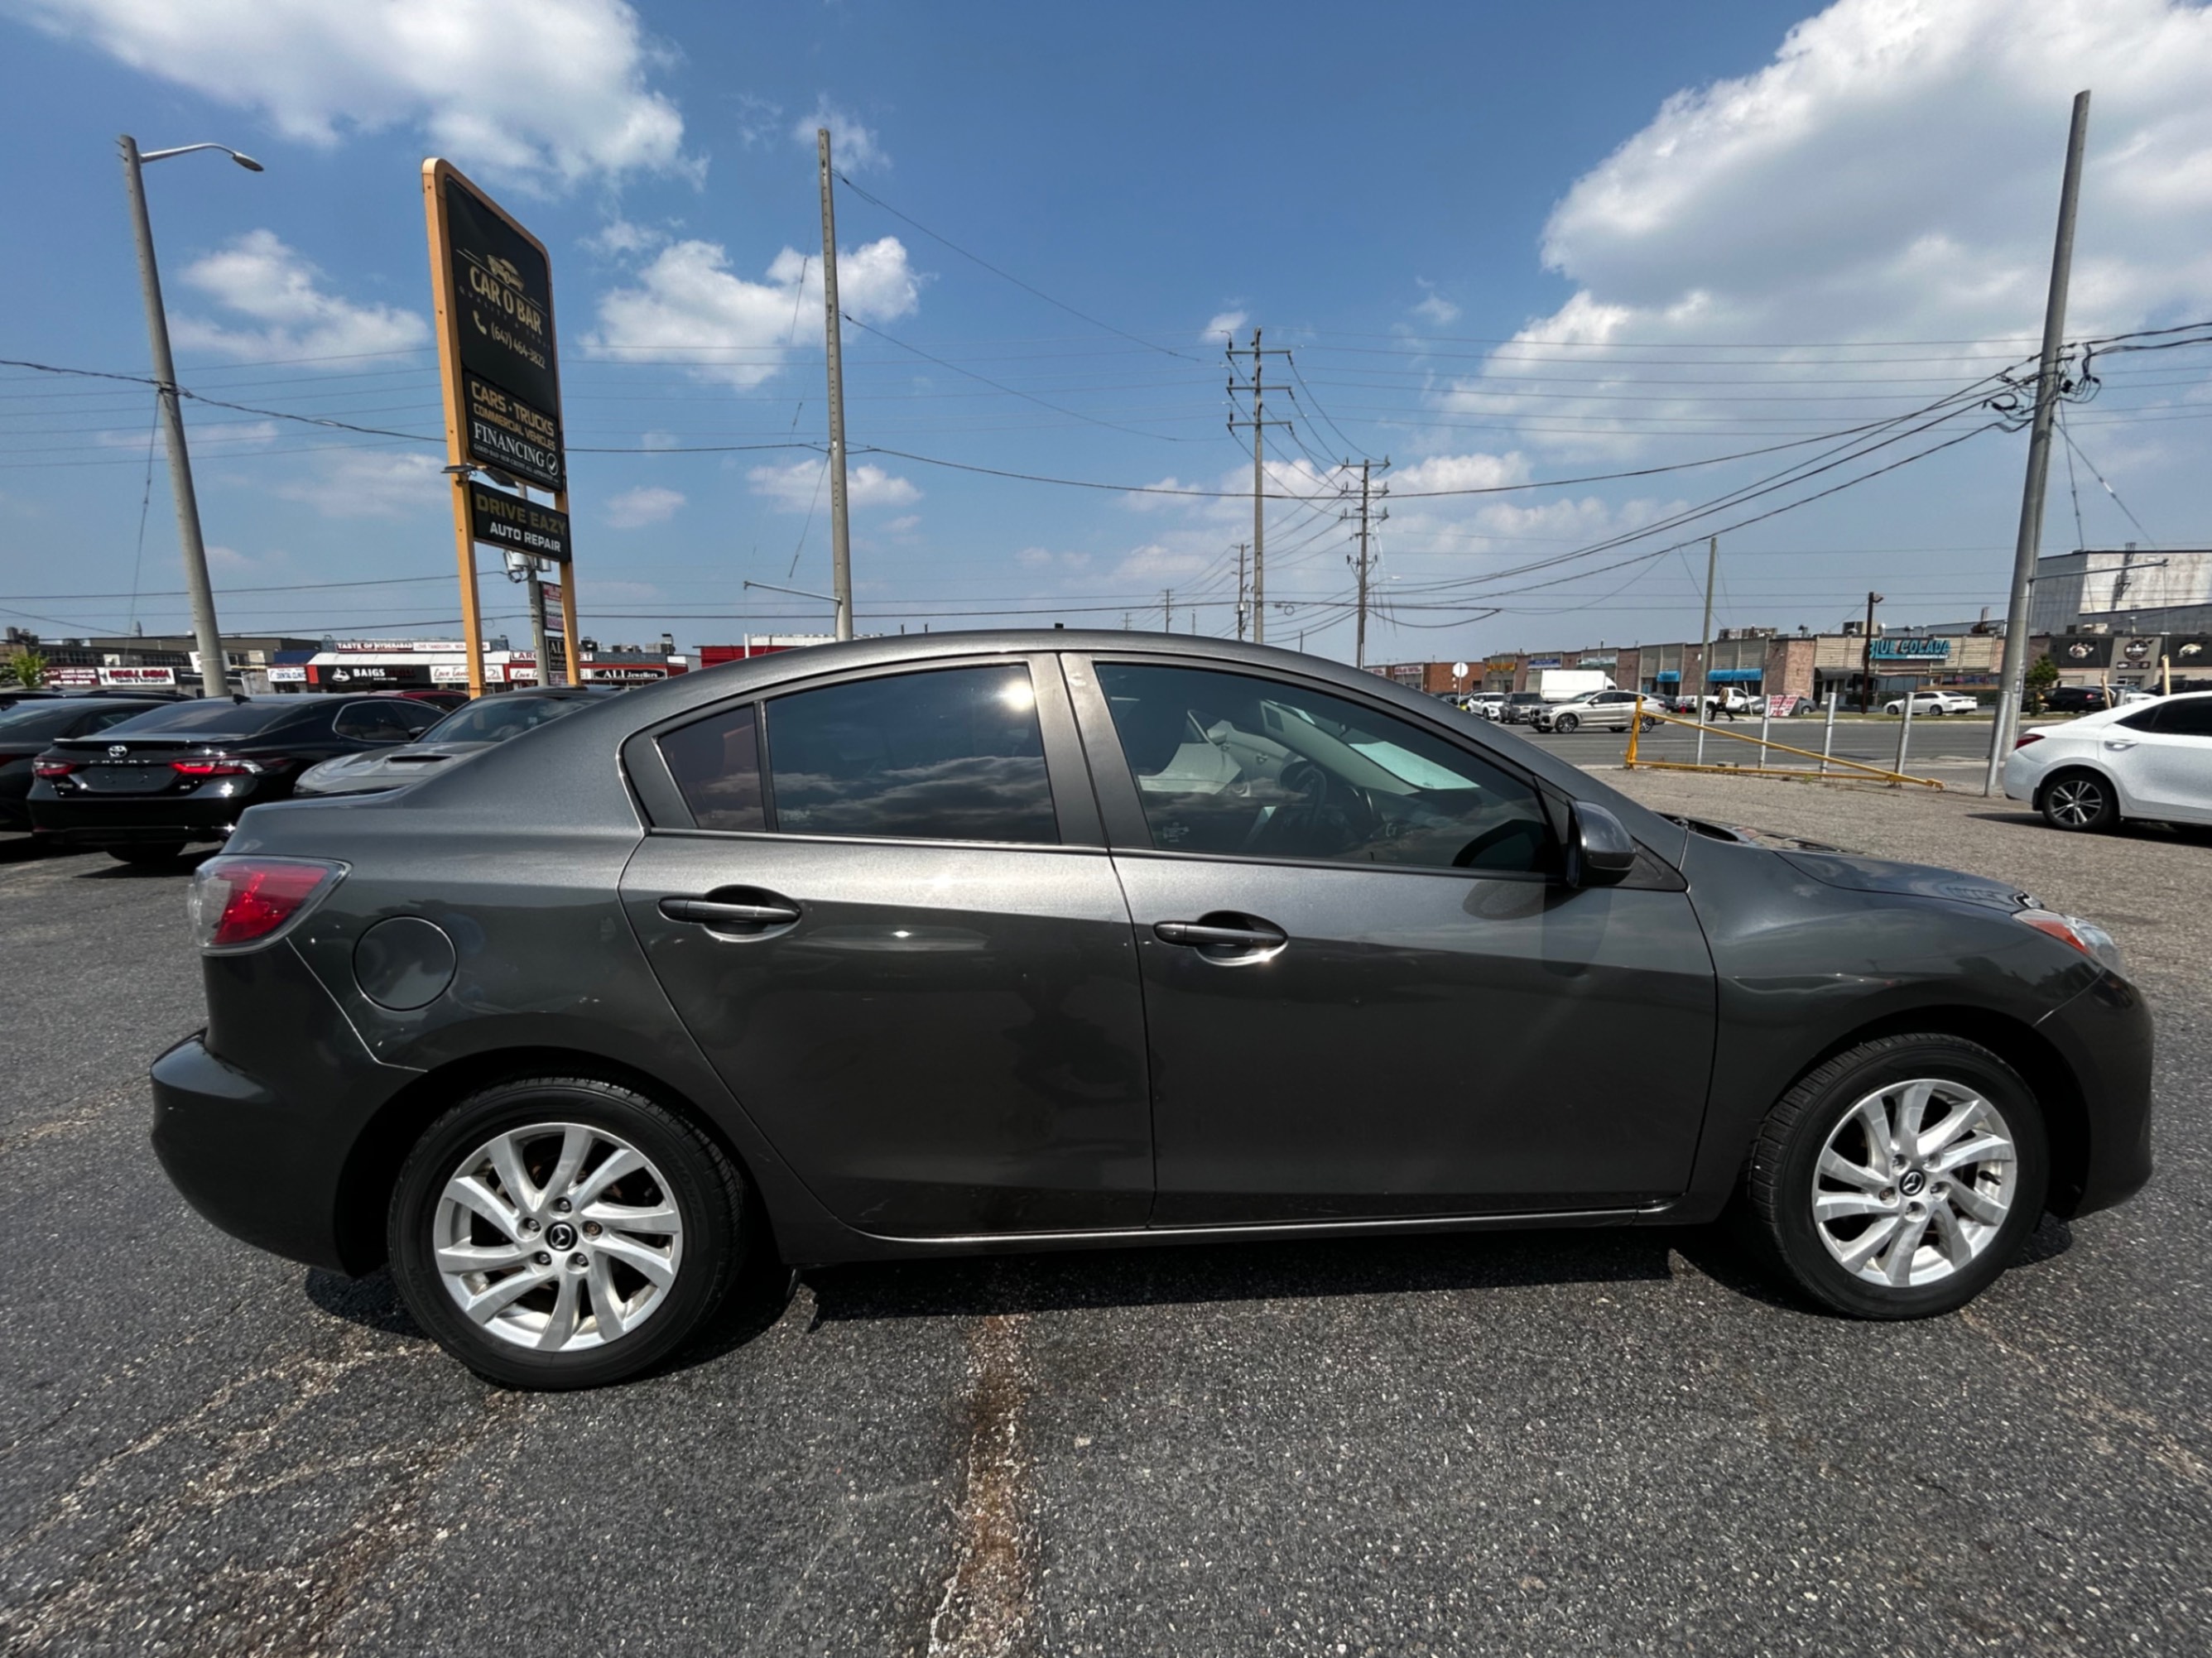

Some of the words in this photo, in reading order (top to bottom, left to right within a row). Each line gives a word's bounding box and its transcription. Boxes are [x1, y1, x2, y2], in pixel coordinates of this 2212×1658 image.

[469, 266, 501, 307] CAR
[503, 289, 513, 314] O
[517, 298, 542, 335] BAR
[472, 381, 507, 412] CARS
[513, 401, 555, 437] TRUCKS
[474, 403, 524, 436] COMMERCIAL
[524, 428, 555, 451] VEHICLES
[474, 421, 545, 467] FINANCING
[476, 493, 527, 523] DRIVE
[531, 511, 566, 536] EAZY
[490, 521, 522, 541] AUTO
[524, 531, 561, 552] REPAIR
[1900, 640, 1950, 654] COLADA
[353, 668, 386, 677] BAIGS
[434, 667, 450, 677] Love
[603, 670, 626, 678] ALI
